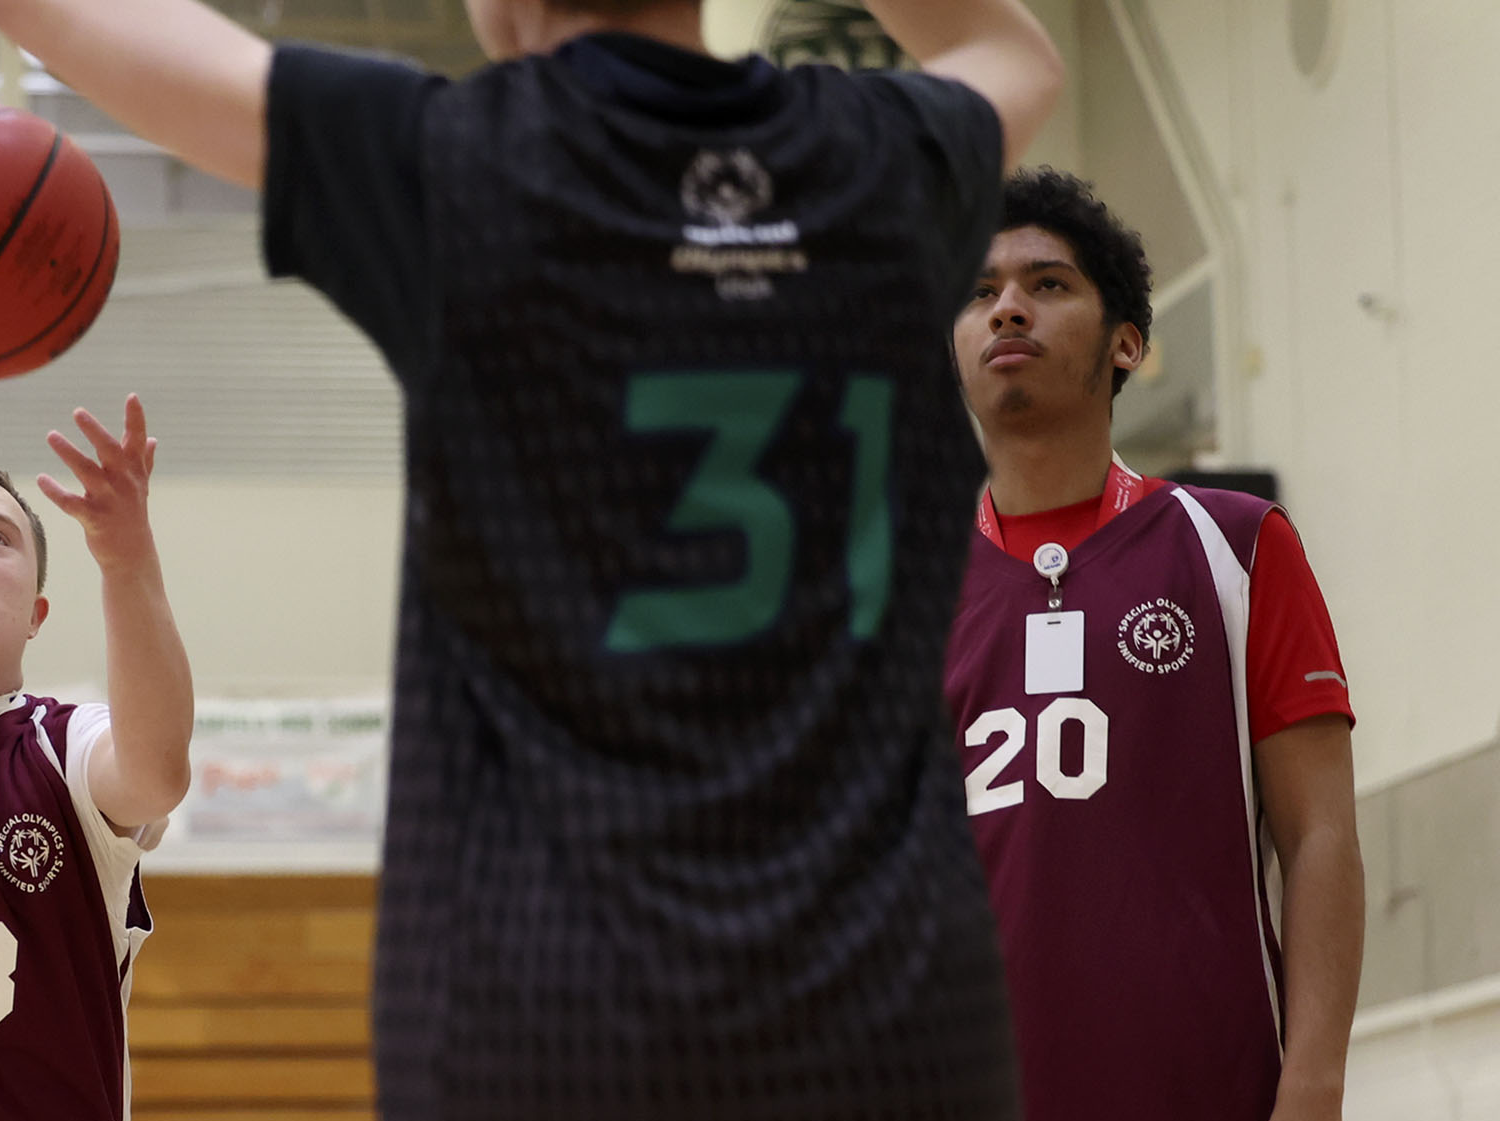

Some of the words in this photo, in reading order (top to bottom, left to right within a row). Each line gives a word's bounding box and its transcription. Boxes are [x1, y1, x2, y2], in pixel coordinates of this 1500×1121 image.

[604, 374, 893, 652] 31
[1118, 601, 1155, 632] SPECIAL
[1156, 598, 1195, 638] OLYMPICS
[1117, 640, 1154, 673] UNIFIED
[1157, 646, 1194, 674] SPORTS
[964, 697, 1109, 816] 20
[21, 813, 64, 850] OLYMPICS
